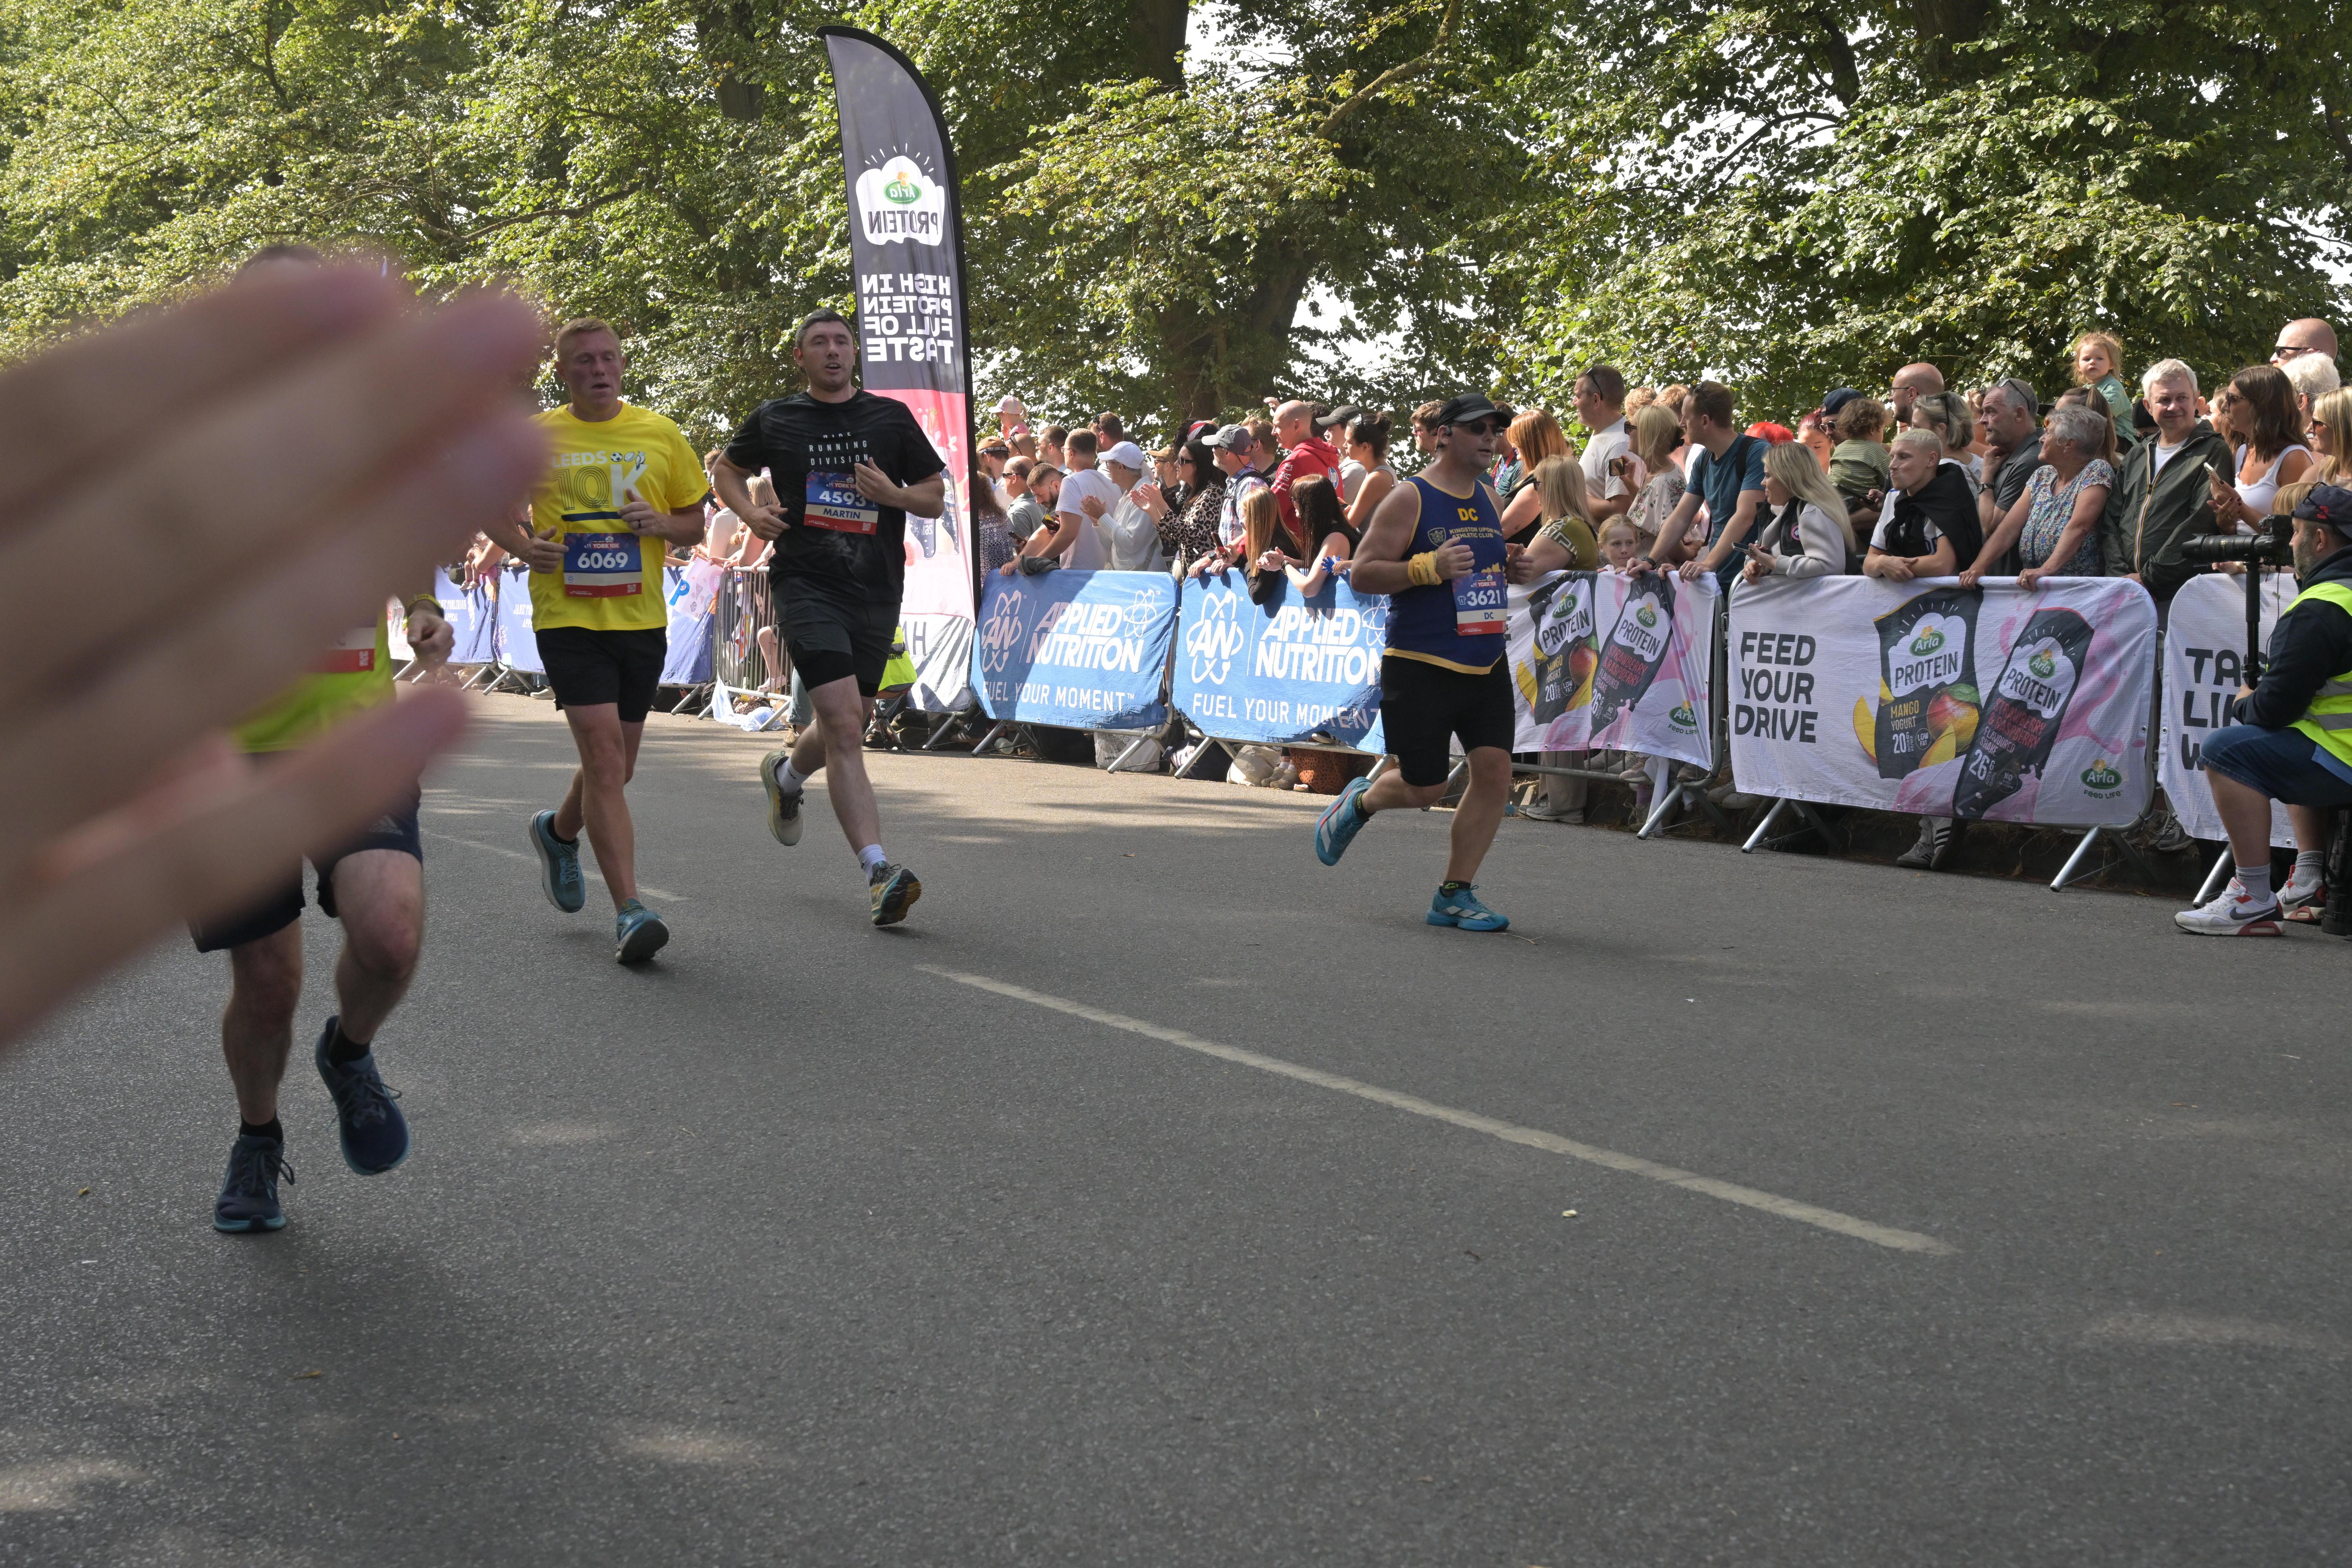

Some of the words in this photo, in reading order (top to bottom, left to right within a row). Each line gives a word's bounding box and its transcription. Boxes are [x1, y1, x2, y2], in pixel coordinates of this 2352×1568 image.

[809, 440, 867, 452] RUNNING
[552, 450, 608, 468] LEEDS
[810, 454, 868, 466] DIVISION
[552, 464, 649, 511] 10K
[1329, 467, 1337, 488] hp
[819, 491, 866, 507] 4593
[823, 508, 861, 519] MARTIN
[1457, 508, 1479, 522] DC
[577, 552, 628, 569] 6069
[447, 599, 466, 610] TOMLINSON
[1467, 590, 1501, 606] 3621
[444, 612, 458, 622] APPEAL
[513, 604, 526, 615] JANE
[1034, 602, 1123, 637] APPLIED
[1638, 610, 1653, 624] Arla
[1260, 606, 1361, 645] APPLIED
[1542, 608, 1590, 649] PROTEIN
[1617, 619, 1661, 656] PROTEIN
[1914, 635, 1939, 652] Arla
[1026, 632, 1144, 673] NUTRITION
[1740, 631, 1816, 667] FEED
[1255, 641, 1383, 686] NUTRITION
[1547, 654, 1563, 674] MANGO
[1608, 644, 1649, 676] STRAWBERRY
[1895, 651, 1959, 689] PROTEIN
[2031, 658, 2051, 674] Arla
[1546, 668, 1561, 684] YOGURT
[1599, 668, 1620, 690] FLAVOURED
[1606, 660, 1642, 687] RASPBERRY
[1545, 683, 1555, 703] 20
[1563, 680, 1573, 689] LOW
[1596, 677, 1608, 693] SHAKE
[1741, 668, 1815, 705] YOUR
[2004, 667, 2062, 711] PROTEIN
[982, 681, 1009, 702] FUEL
[1015, 683, 1049, 705] YOUR
[1054, 686, 1127, 712] MOMENT
[1193, 693, 1238, 719] FUEL
[1244, 698, 1289, 724] YOUR
[1674, 709, 1695, 722] Arla
[1891, 700, 1919, 719] MANGO
[1993, 698, 2047, 736] STRAWBERRY
[1734, 704, 1819, 744] DRIVE
[1891, 716, 1916, 731] YOGURT
[1995, 716, 2042, 749] RASPBERRY
[1892, 732, 1907, 754] 20
[1917, 732, 1929, 741] LOW
[1979, 736, 1999, 757] SHAKE
[1983, 726, 2016, 753] FLAVOURED
[1969, 749, 1990, 781] 26
[2004, 772, 2013, 781] NO
[2086, 771, 2115, 784] Arla
